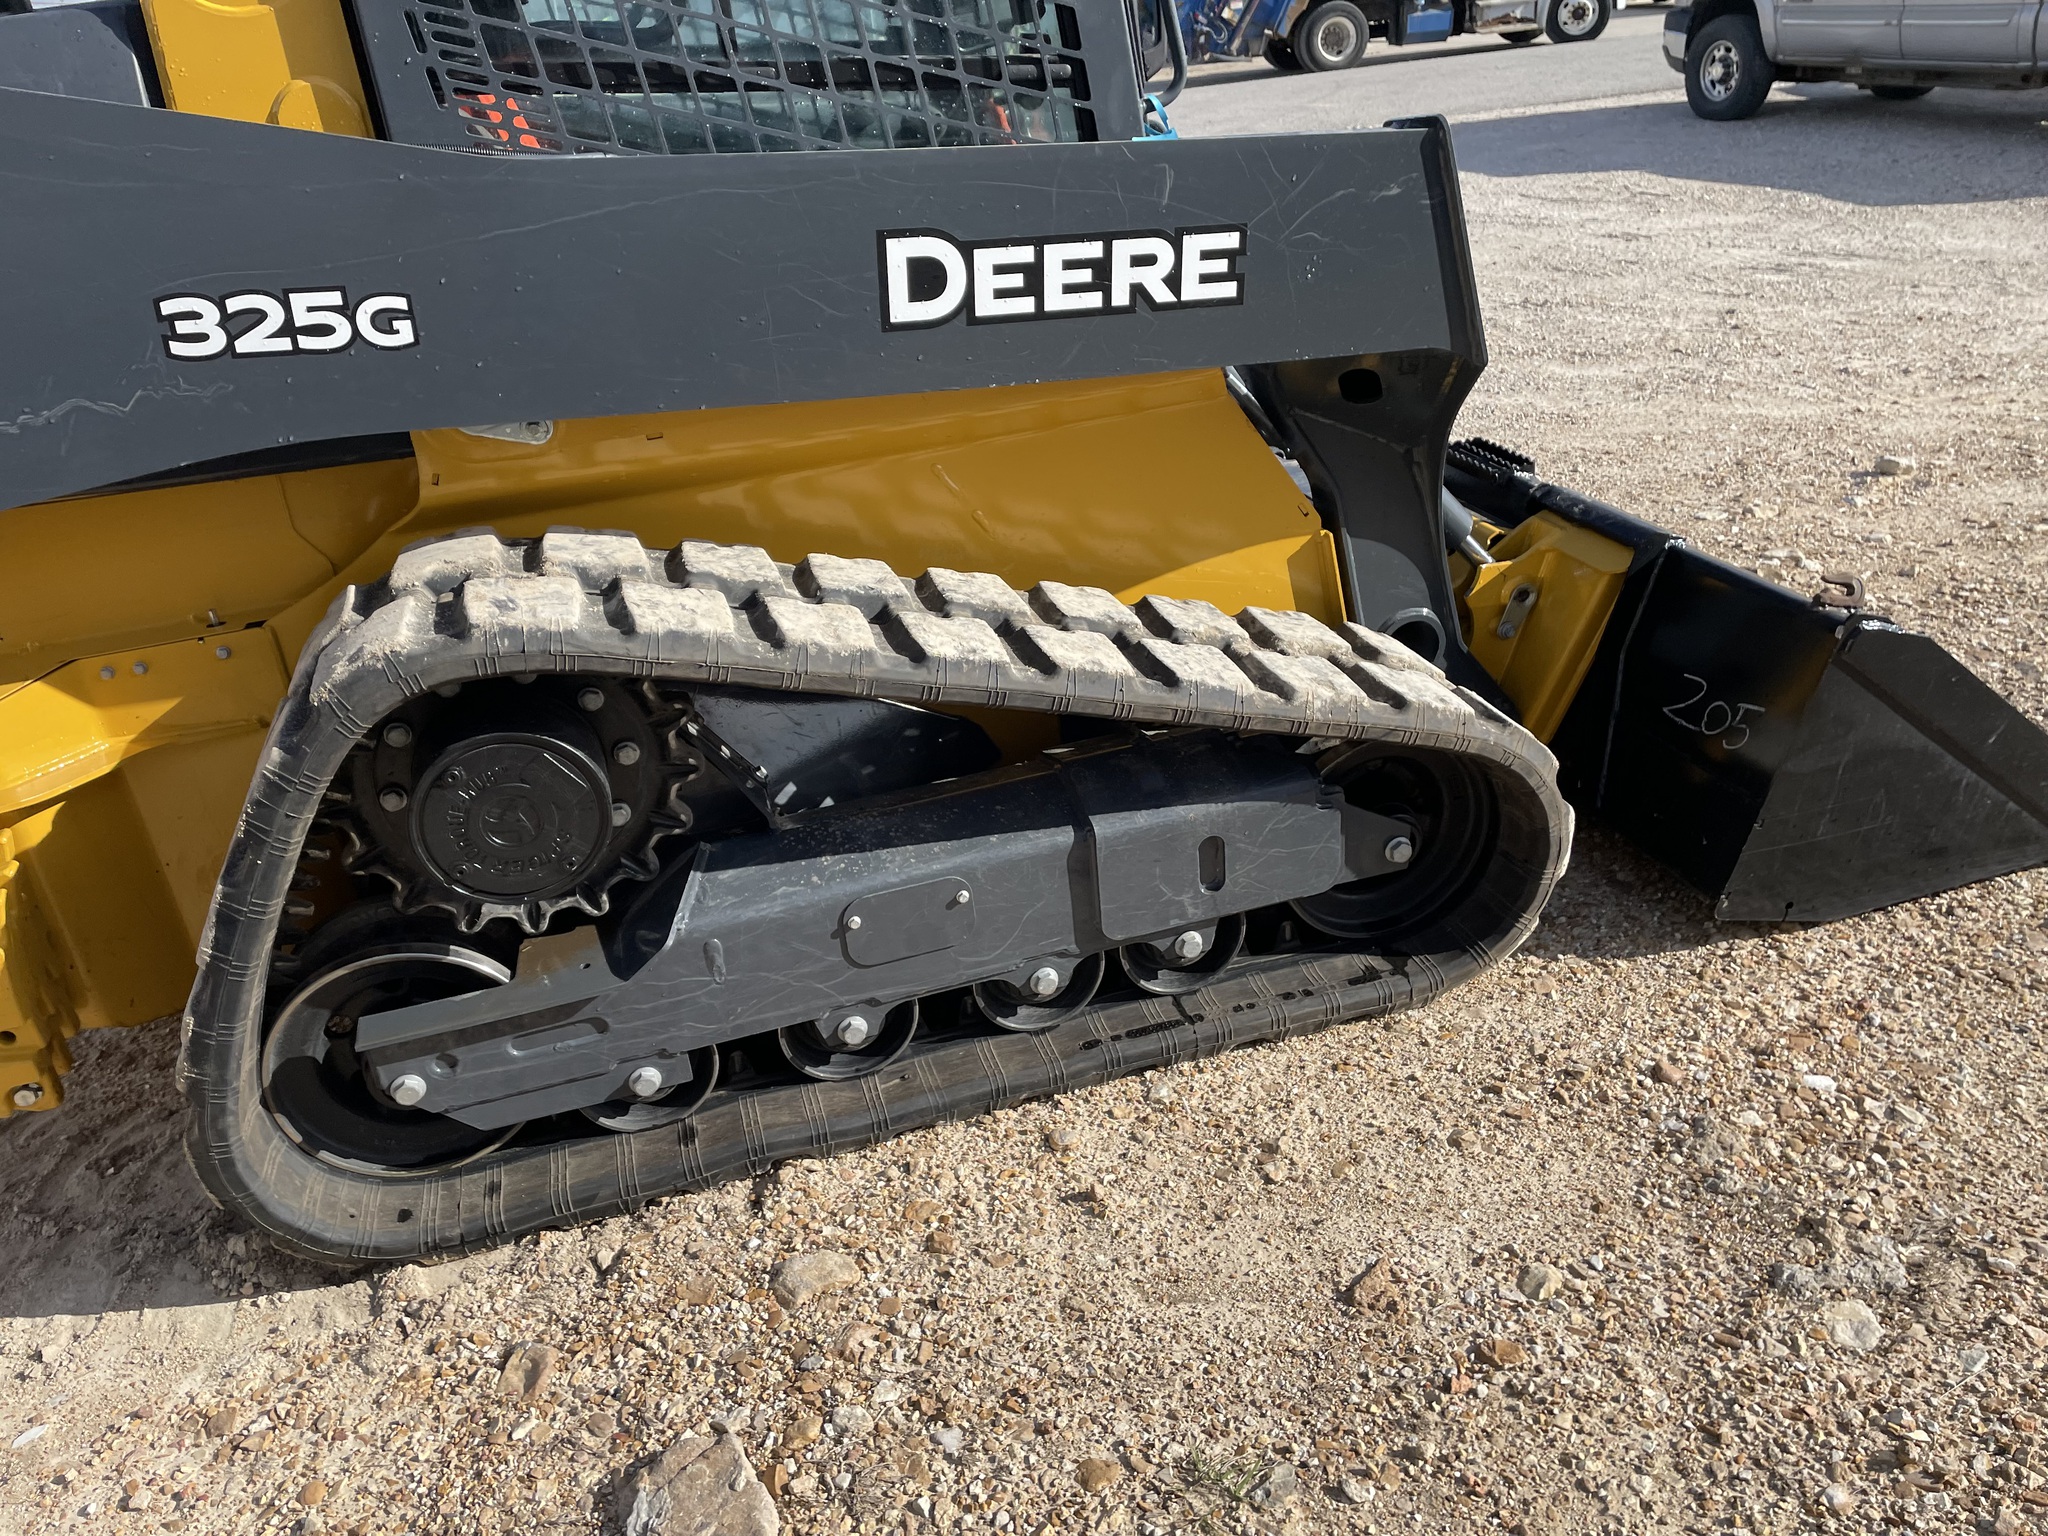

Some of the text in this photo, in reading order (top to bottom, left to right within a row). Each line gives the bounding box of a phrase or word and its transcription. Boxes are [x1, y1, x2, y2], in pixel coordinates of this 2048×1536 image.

[884, 230, 1241, 324] DEERE
[157, 289, 416, 358] 325G
[1662, 673, 1766, 750] 205
